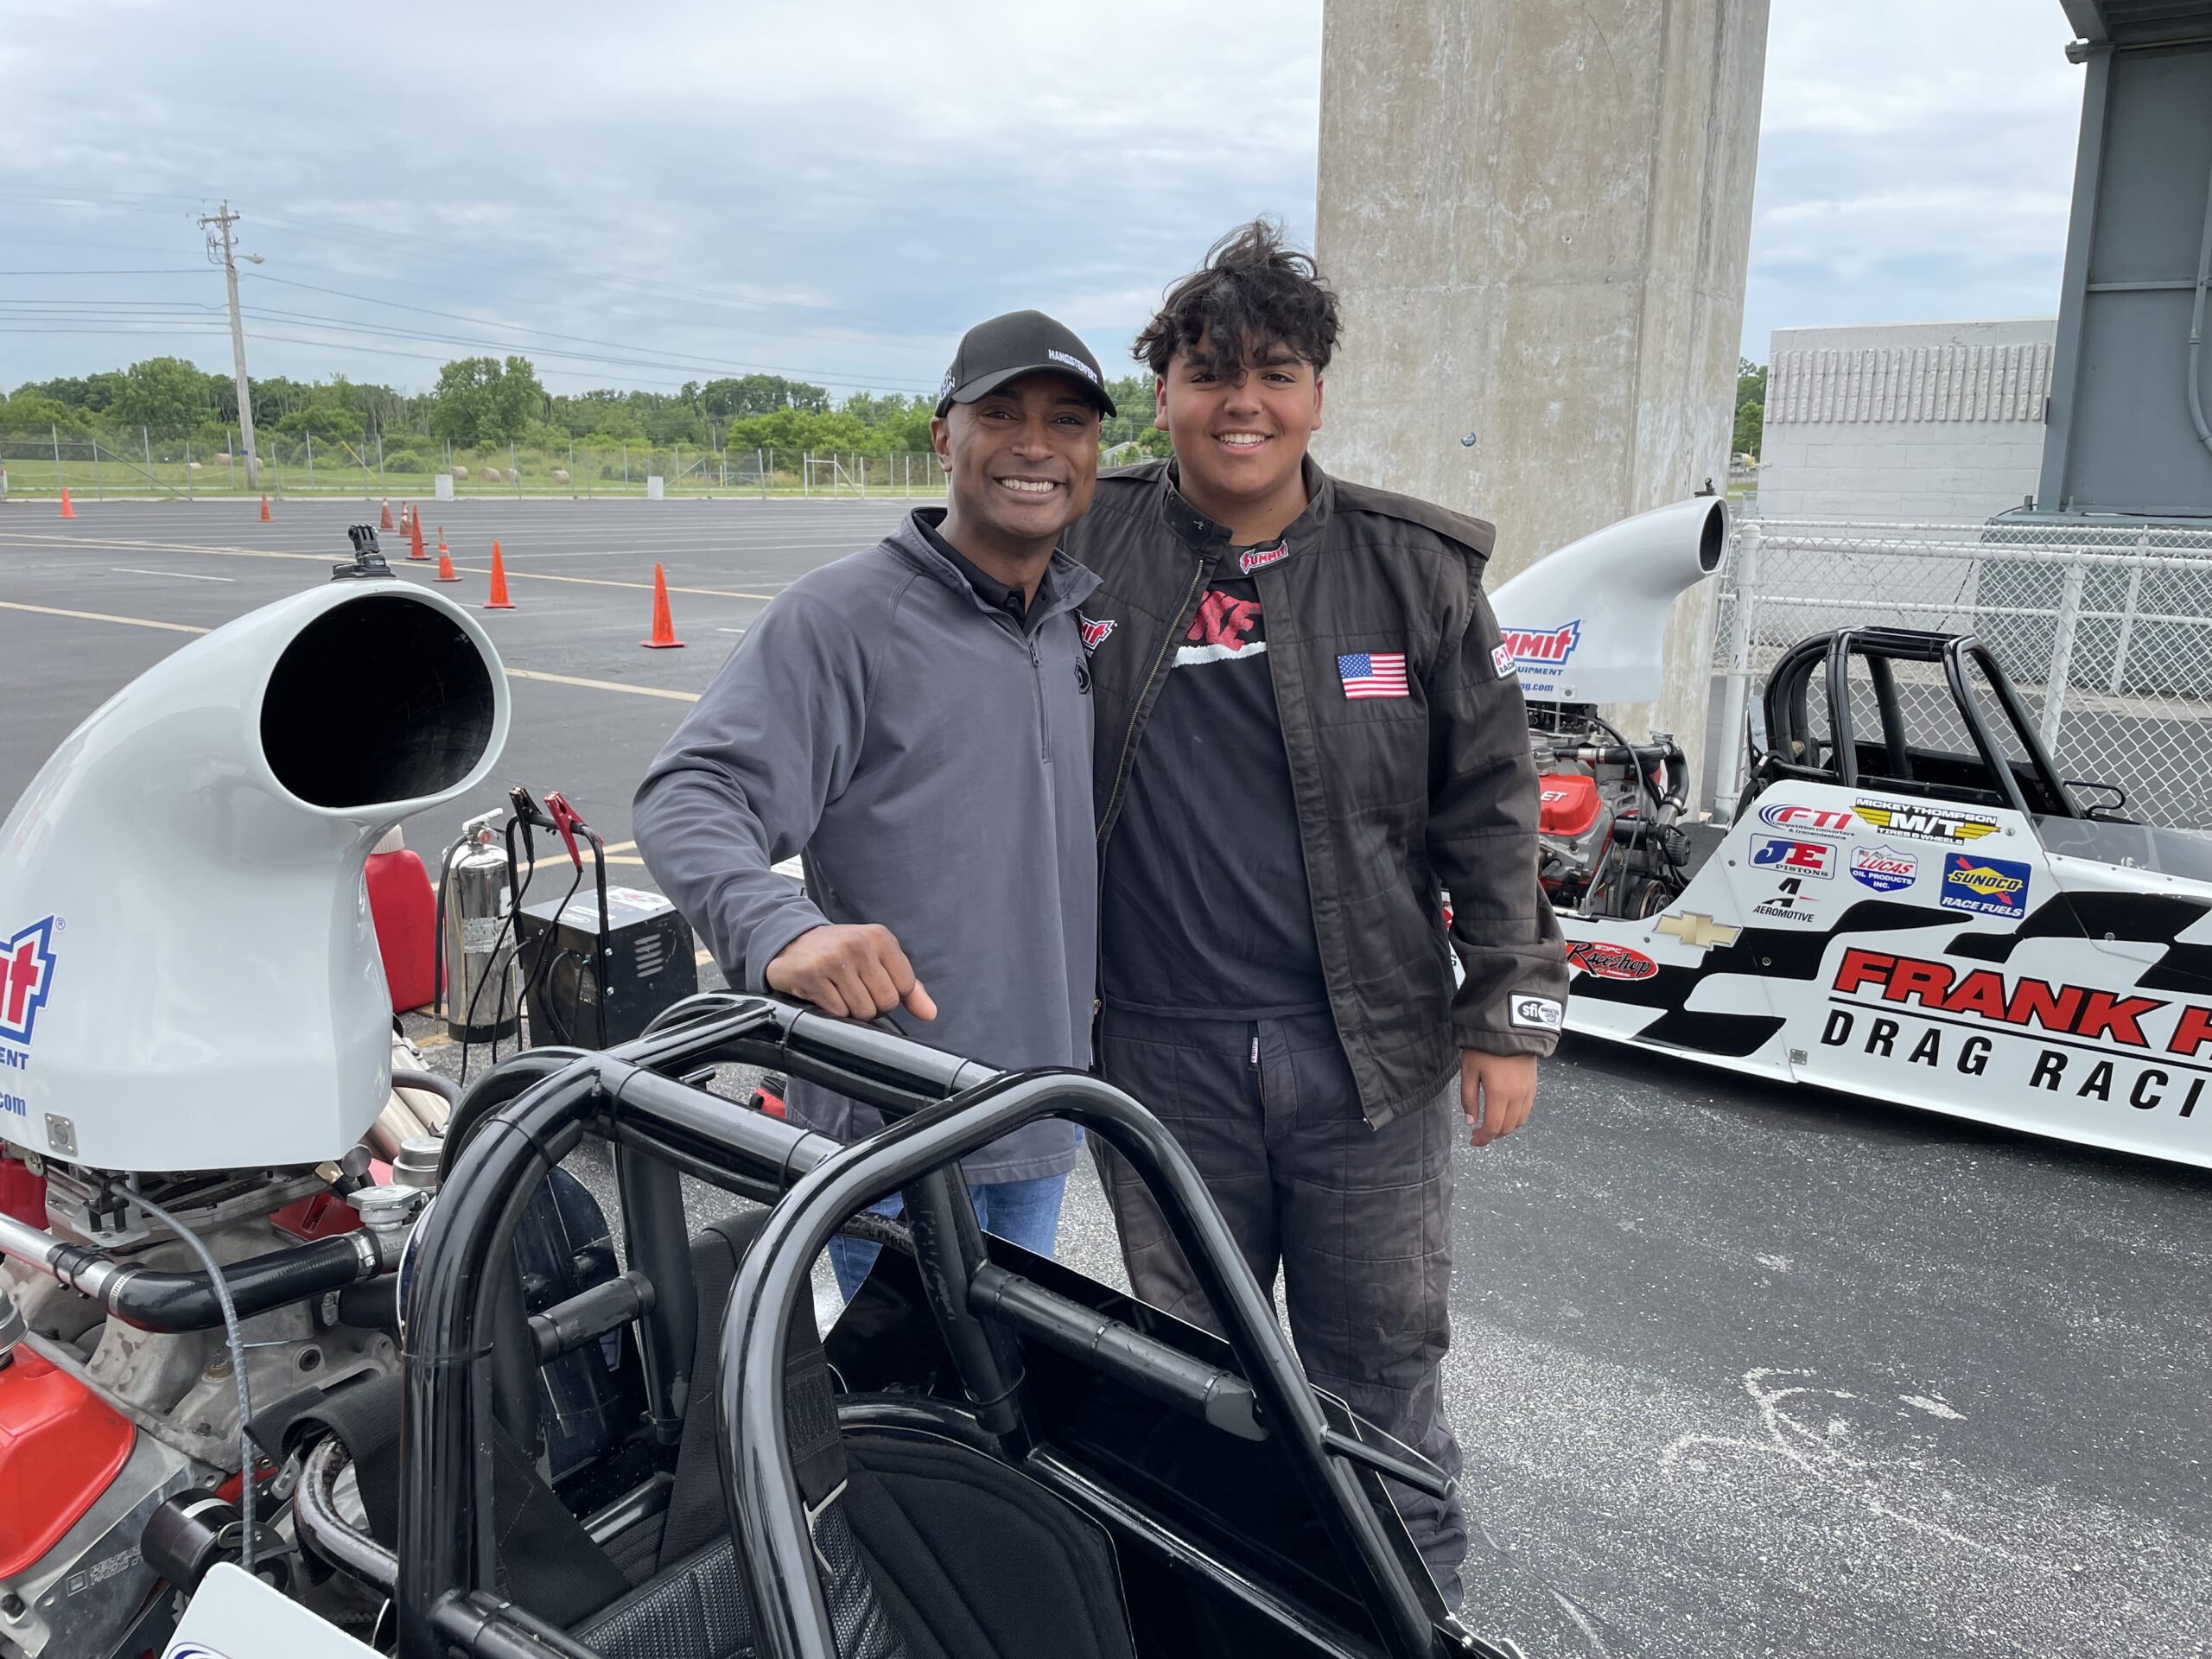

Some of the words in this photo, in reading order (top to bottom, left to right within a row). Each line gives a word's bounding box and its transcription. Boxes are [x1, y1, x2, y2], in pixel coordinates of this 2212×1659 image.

[1516, 666, 1564, 676] UIPMENT
[1856, 798, 1911, 811] MICKEY
[1912, 805, 1998, 824] THOMPSON
[1889, 812, 1965, 836] M/T
[1878, 827, 1911, 838] TIRES
[1920, 834, 1964, 846] WHEELS
[1753, 840, 1827, 869] JE
[1776, 863, 1828, 877] PISTONS
[1858, 857, 1914, 874] LUCAS
[1868, 872, 1913, 886] PRODUCTS
[1950, 871, 2021, 891] SUNOCO
[1752, 905, 1815, 923] AEROMOTIVE
[1941, 896, 1981, 910] RACE
[1980, 902, 2024, 917] FUELS
[1831, 947, 2173, 1049] FRANK
[1820, 1009, 1993, 1077] DRAG
[2028, 1049, 2207, 1118] RACI
